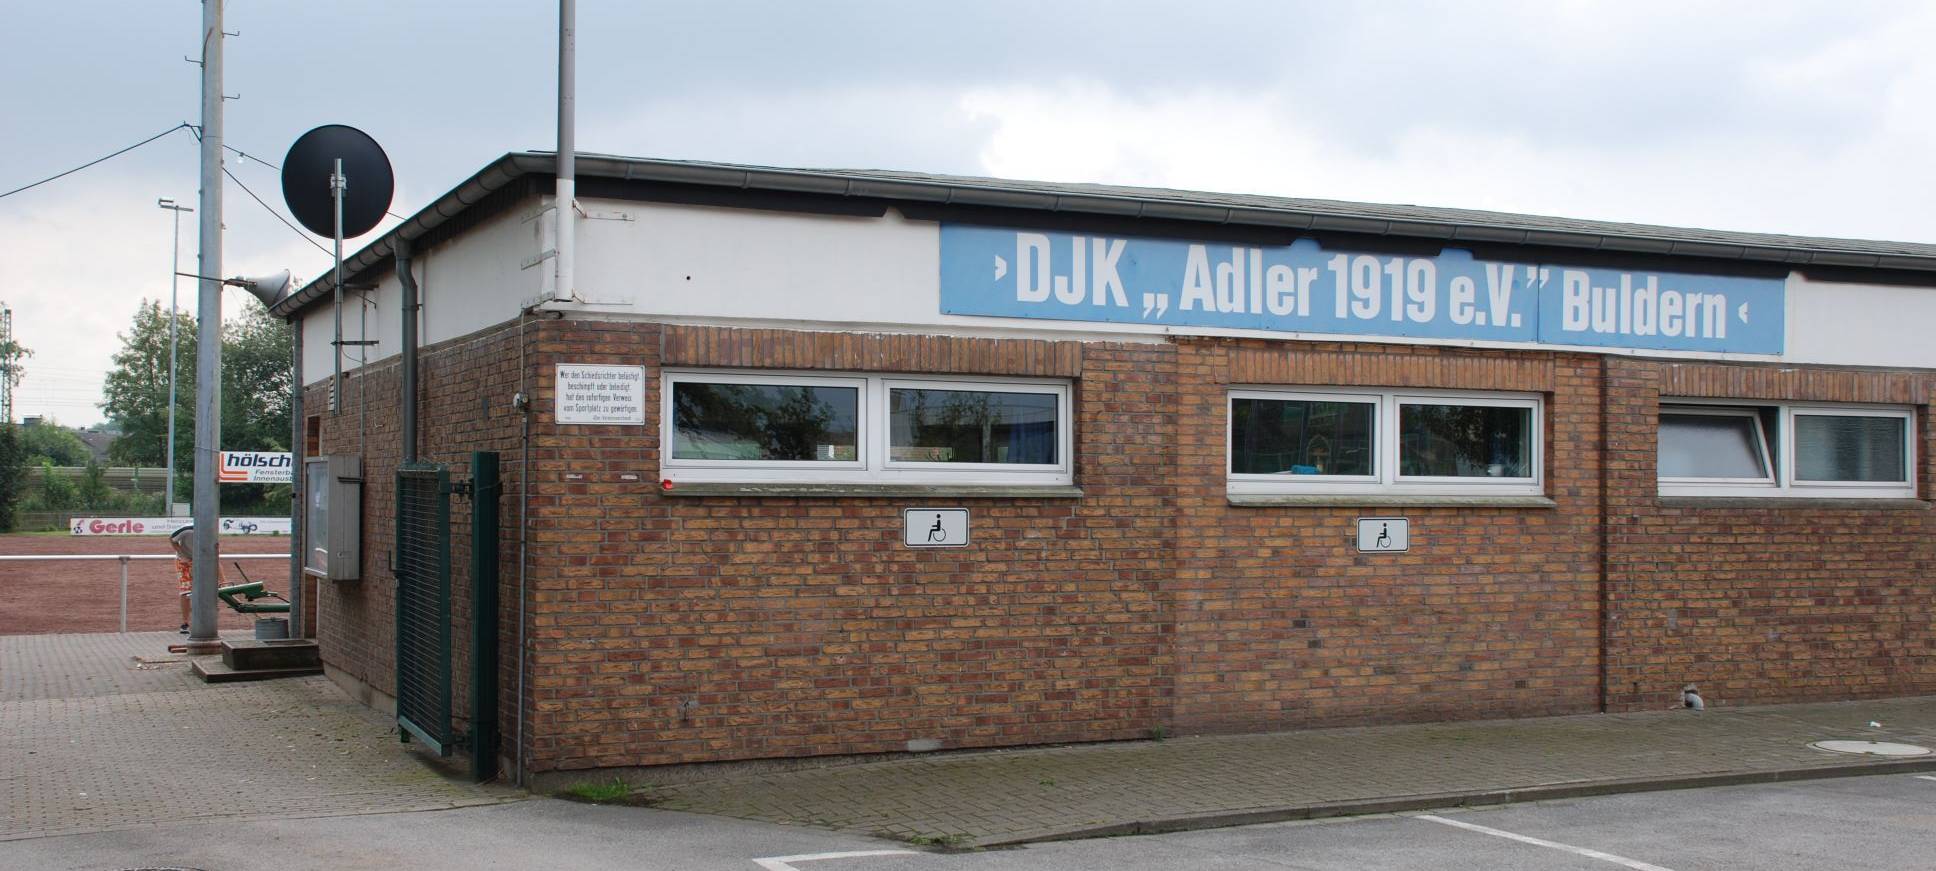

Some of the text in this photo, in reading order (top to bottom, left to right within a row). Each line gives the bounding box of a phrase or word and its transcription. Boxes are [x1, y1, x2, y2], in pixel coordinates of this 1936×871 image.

[1016, 232, 1129, 307] DJK
[1328, 254, 1435, 323] 1919
[1562, 269, 1727, 339] Buldern
[560, 370, 569, 380] Wer
[570, 371, 580, 380] den
[581, 370, 617, 380] Schiedsrichter
[596, 383, 608, 391] oder
[565, 393, 575, 401] hat
[575, 393, 585, 401] den
[575, 403, 601, 413] Sportplatz
[226, 453, 292, 468] hölsch
[89, 519, 145, 534] Gerle
